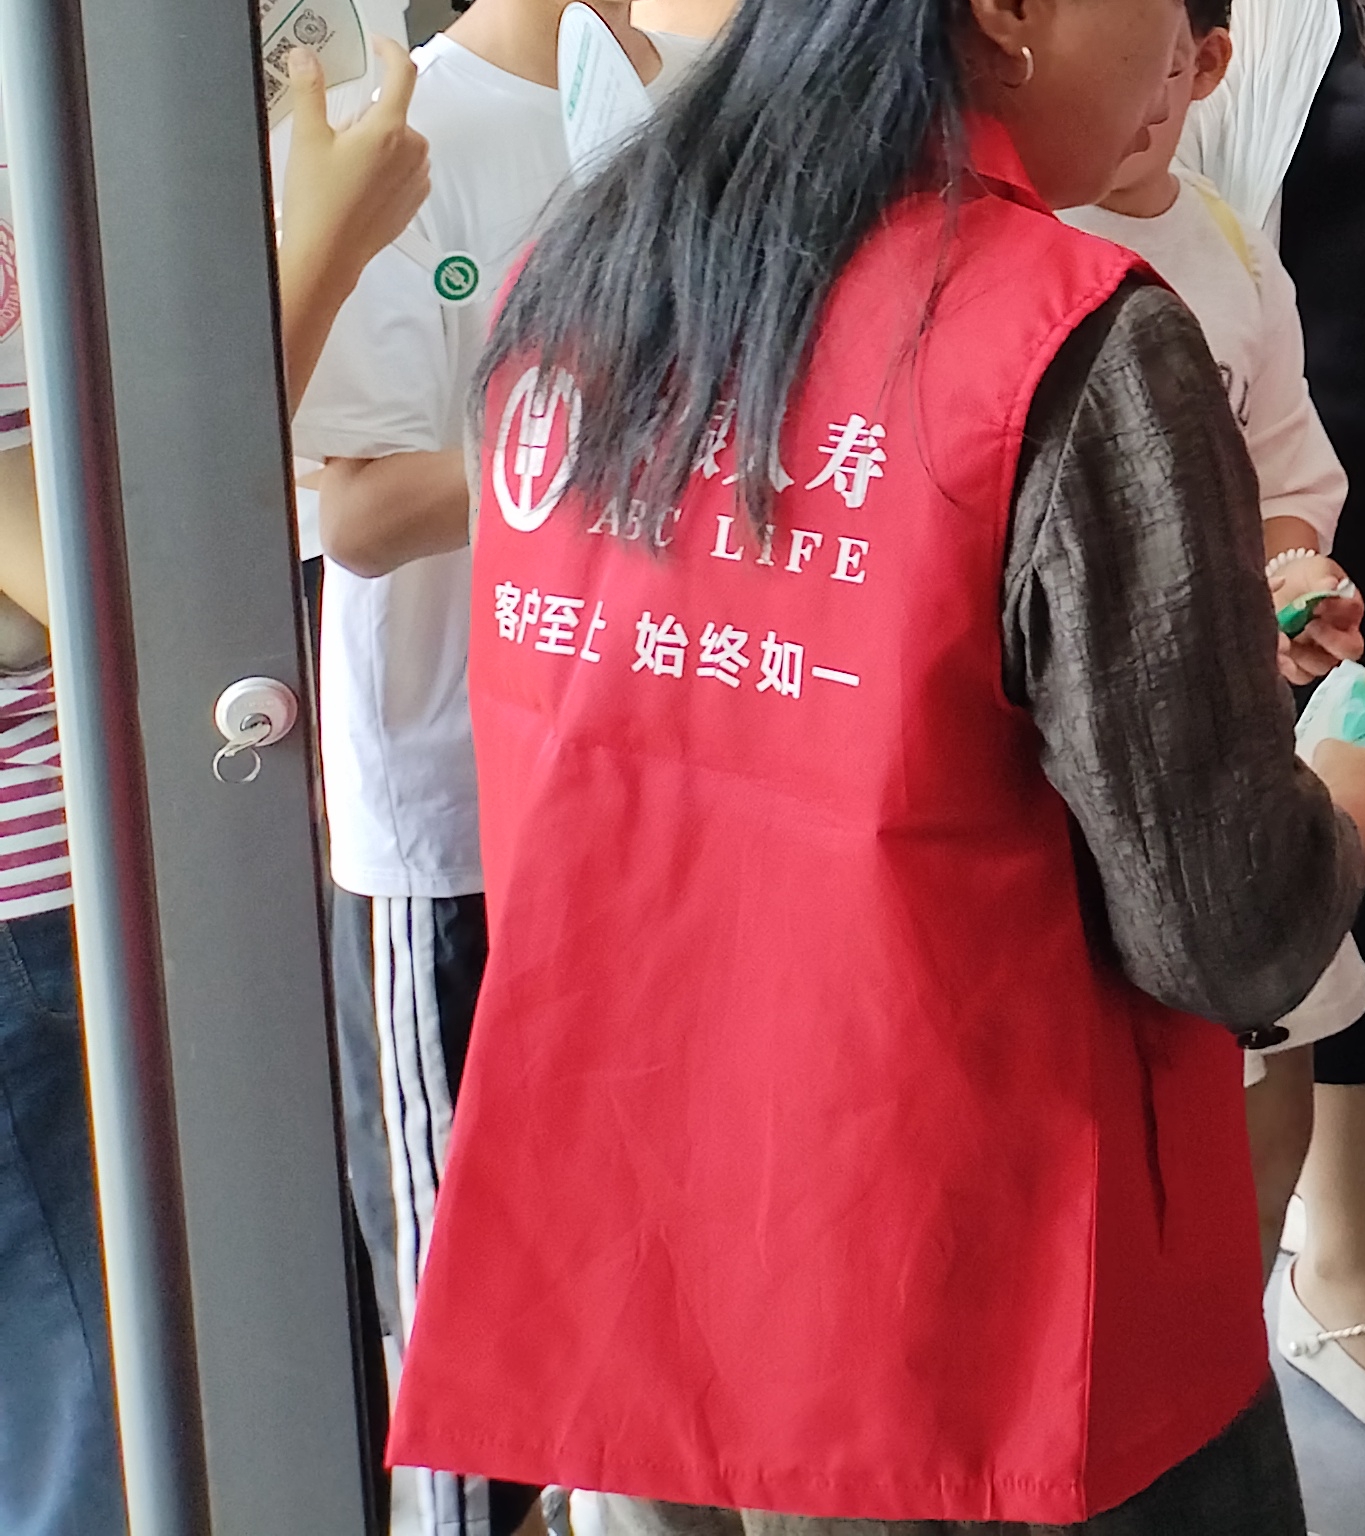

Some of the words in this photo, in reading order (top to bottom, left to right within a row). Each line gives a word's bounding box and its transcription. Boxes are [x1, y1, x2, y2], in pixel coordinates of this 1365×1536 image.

[710, 514, 869, 584] LIFE
[494, 580, 606, 663] 客户至上
[632, 611, 860, 698] 始终如一
